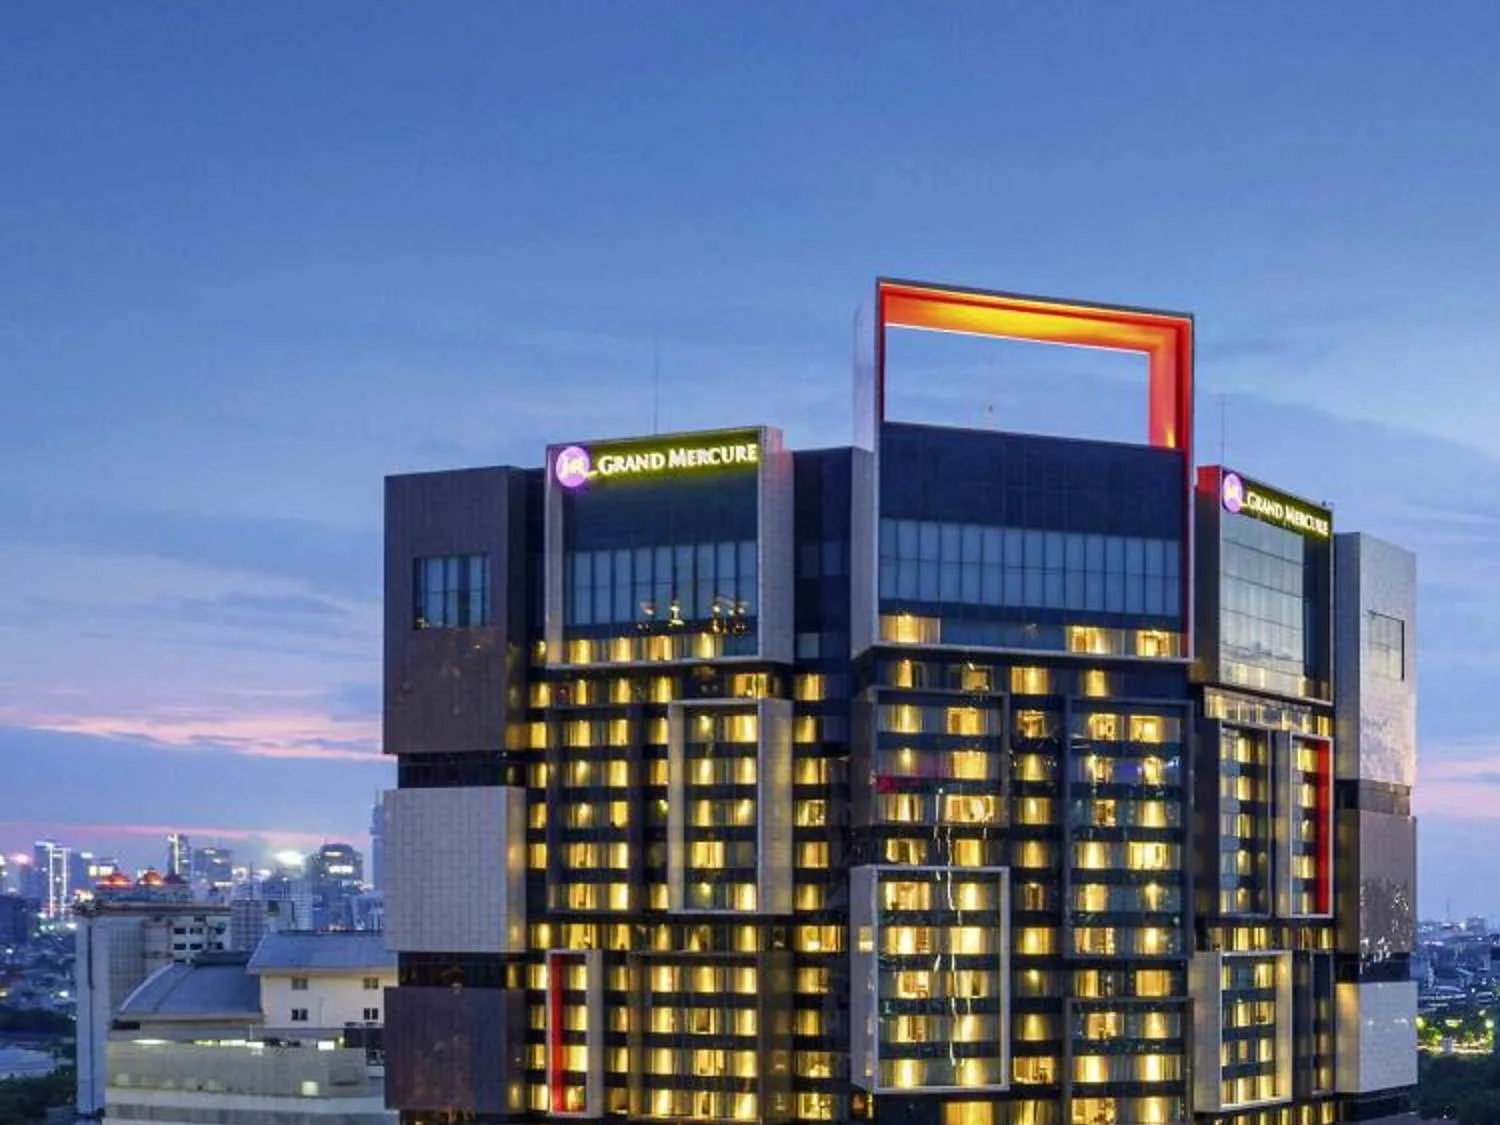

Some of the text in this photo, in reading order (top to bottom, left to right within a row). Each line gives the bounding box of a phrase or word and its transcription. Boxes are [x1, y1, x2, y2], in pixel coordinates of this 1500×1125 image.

[598, 452, 664, 476] GRAND
[669, 443, 758, 468] MERCURE
[1247, 492, 1284, 519] GRAND
